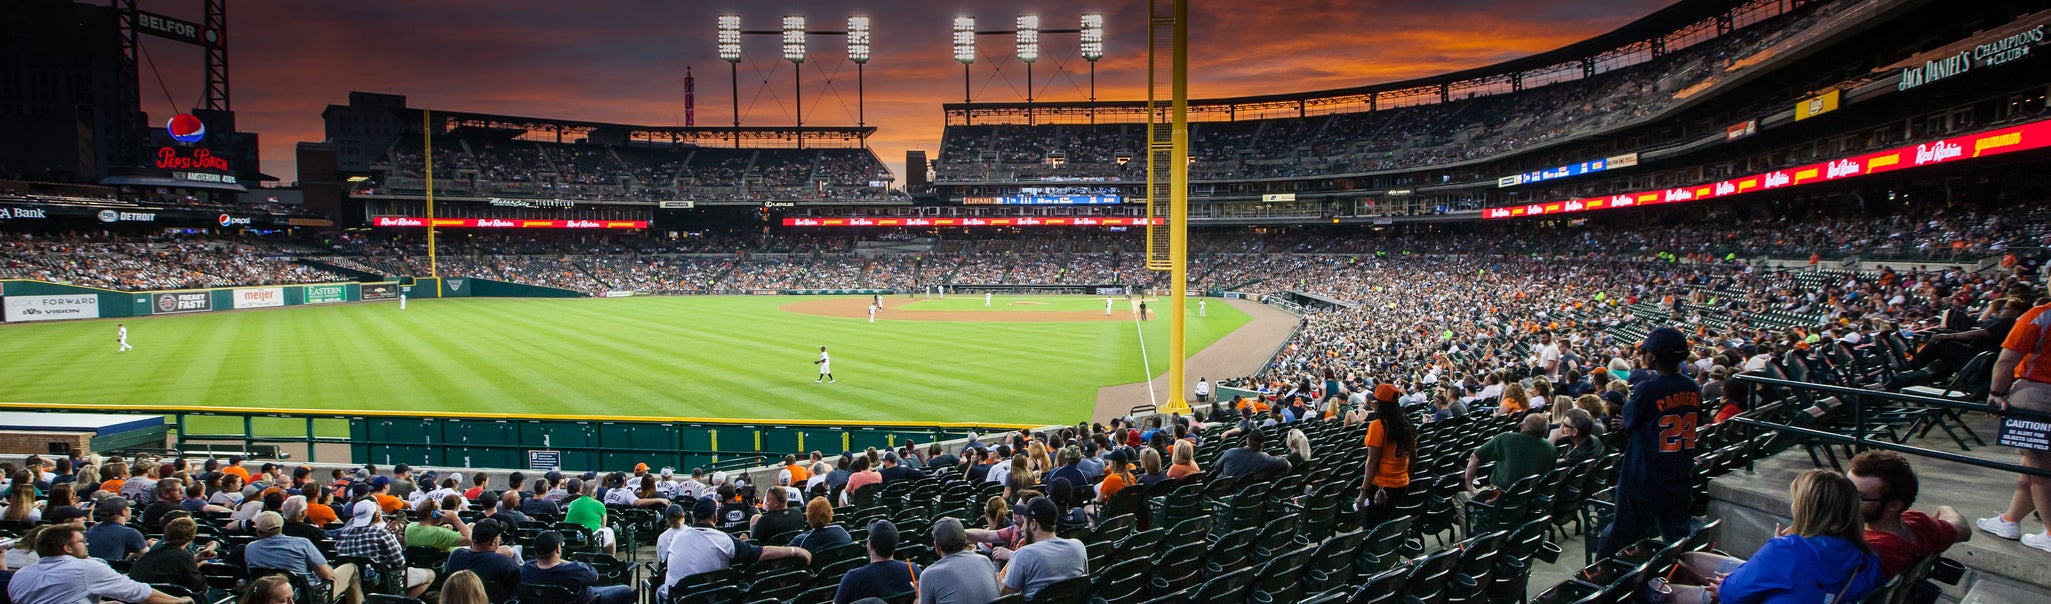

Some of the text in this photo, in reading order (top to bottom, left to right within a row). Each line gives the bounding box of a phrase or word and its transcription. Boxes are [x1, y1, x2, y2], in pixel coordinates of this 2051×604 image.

[138, 13, 196, 38] BELFOR
[1973, 24, 2044, 60] CHAMPIONS
[1993, 49, 2022, 65] CLUB
[1898, 50, 1970, 91] JACK DANIEL'S
[1915, 143, 1933, 165] Red
[1933, 140, 1962, 161] Robin
[13, 207, 46, 218] Bank
[119, 212, 155, 221] DETROIT
[231, 217, 251, 225] pepsi
[380, 217, 397, 226] Red
[397, 217, 422, 226] Robin
[477, 218, 492, 227] Red
[492, 218, 514, 227] Robin
[566, 219, 580, 228] Red
[580, 219, 600, 228] Robin
[245, 288, 273, 301] meijer
[309, 286, 341, 296] EASTERN
[42, 297, 96, 306] FORWARD
[177, 299, 206, 309] FAST!
[2005, 419, 2051, 431] CAUTION!
[1659, 412, 1698, 452] 24
